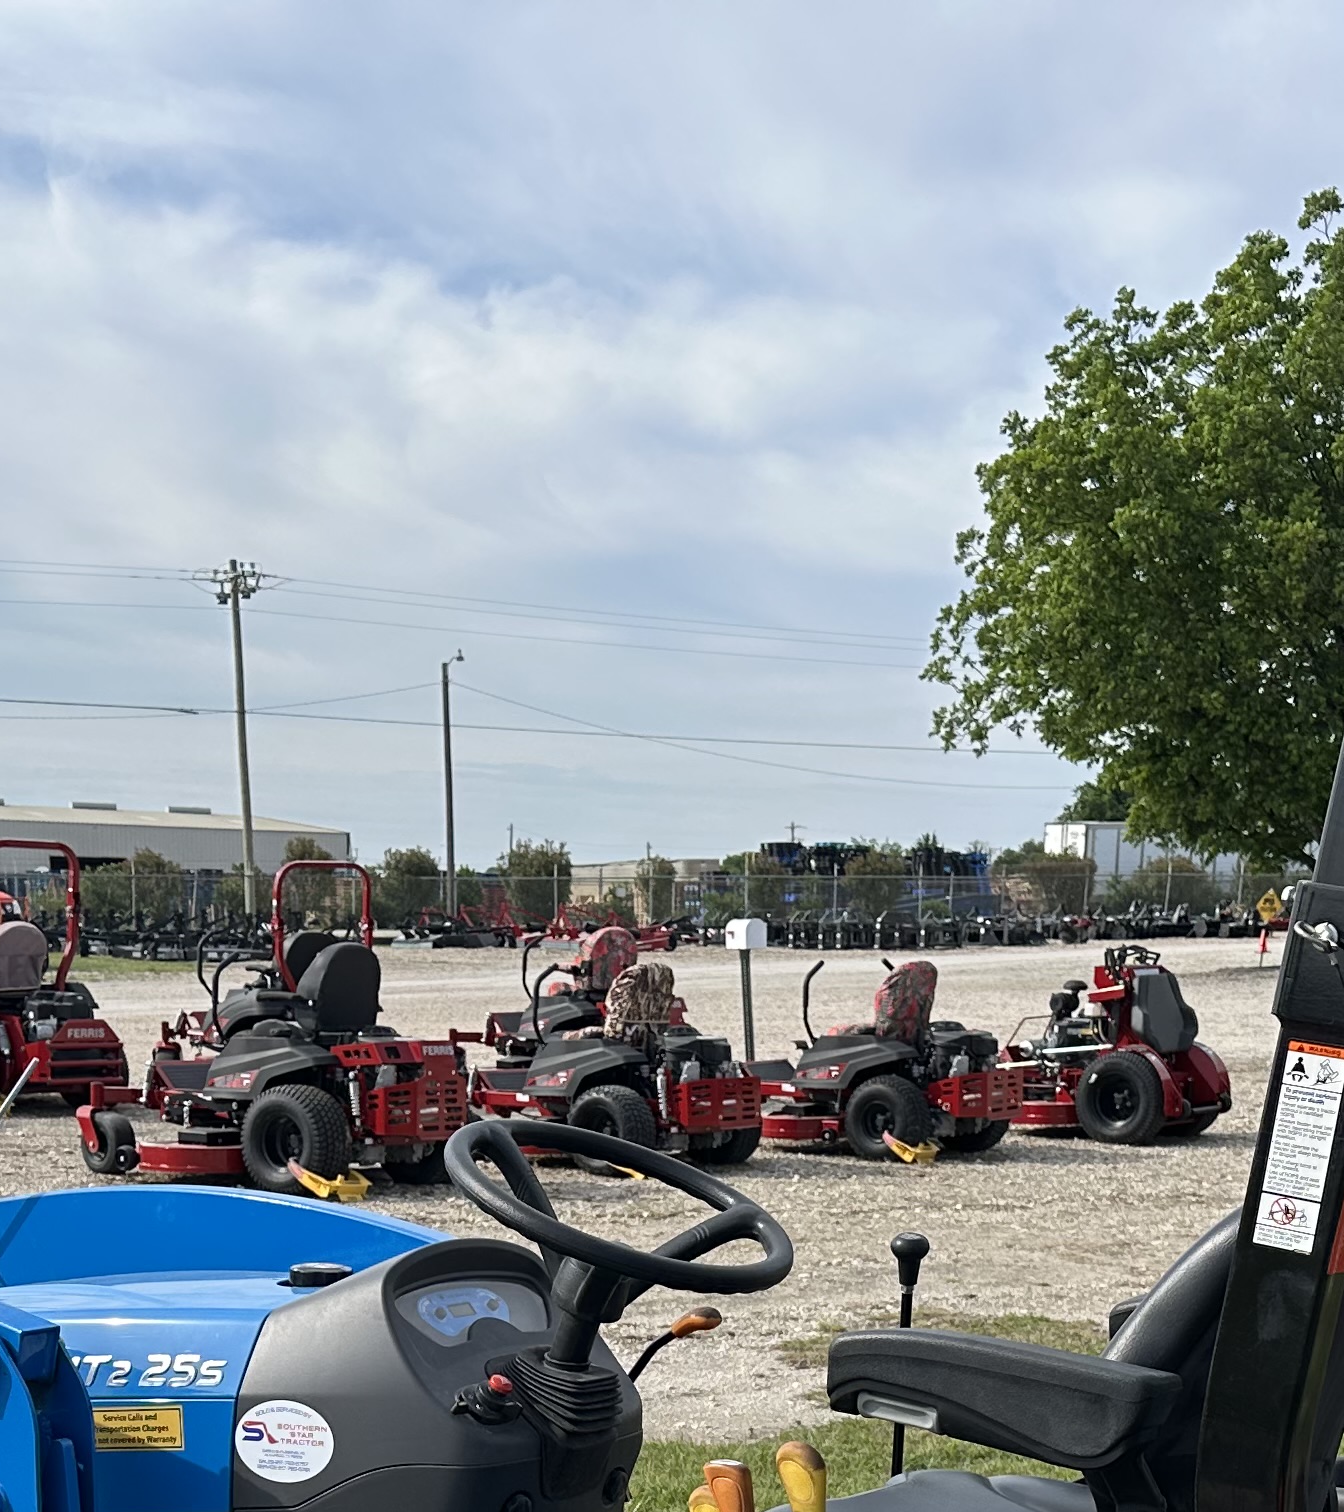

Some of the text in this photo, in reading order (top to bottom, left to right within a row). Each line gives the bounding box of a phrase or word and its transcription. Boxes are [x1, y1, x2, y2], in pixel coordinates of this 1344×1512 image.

[67, 1027, 105, 1039] FERRIS
[422, 1045, 455, 1056] FERRIS
[72, 1355, 132, 1387] T2
[102, 1414, 127, 1422] Service
[142, 1424, 169, 1433] Charges
[277, 1423, 328, 1433] SOUTHERN
[290, 1431, 314, 1439] STAR
[146, 1436, 177, 1444] Warranty
[280, 1438, 325, 1447] TRACTOR
